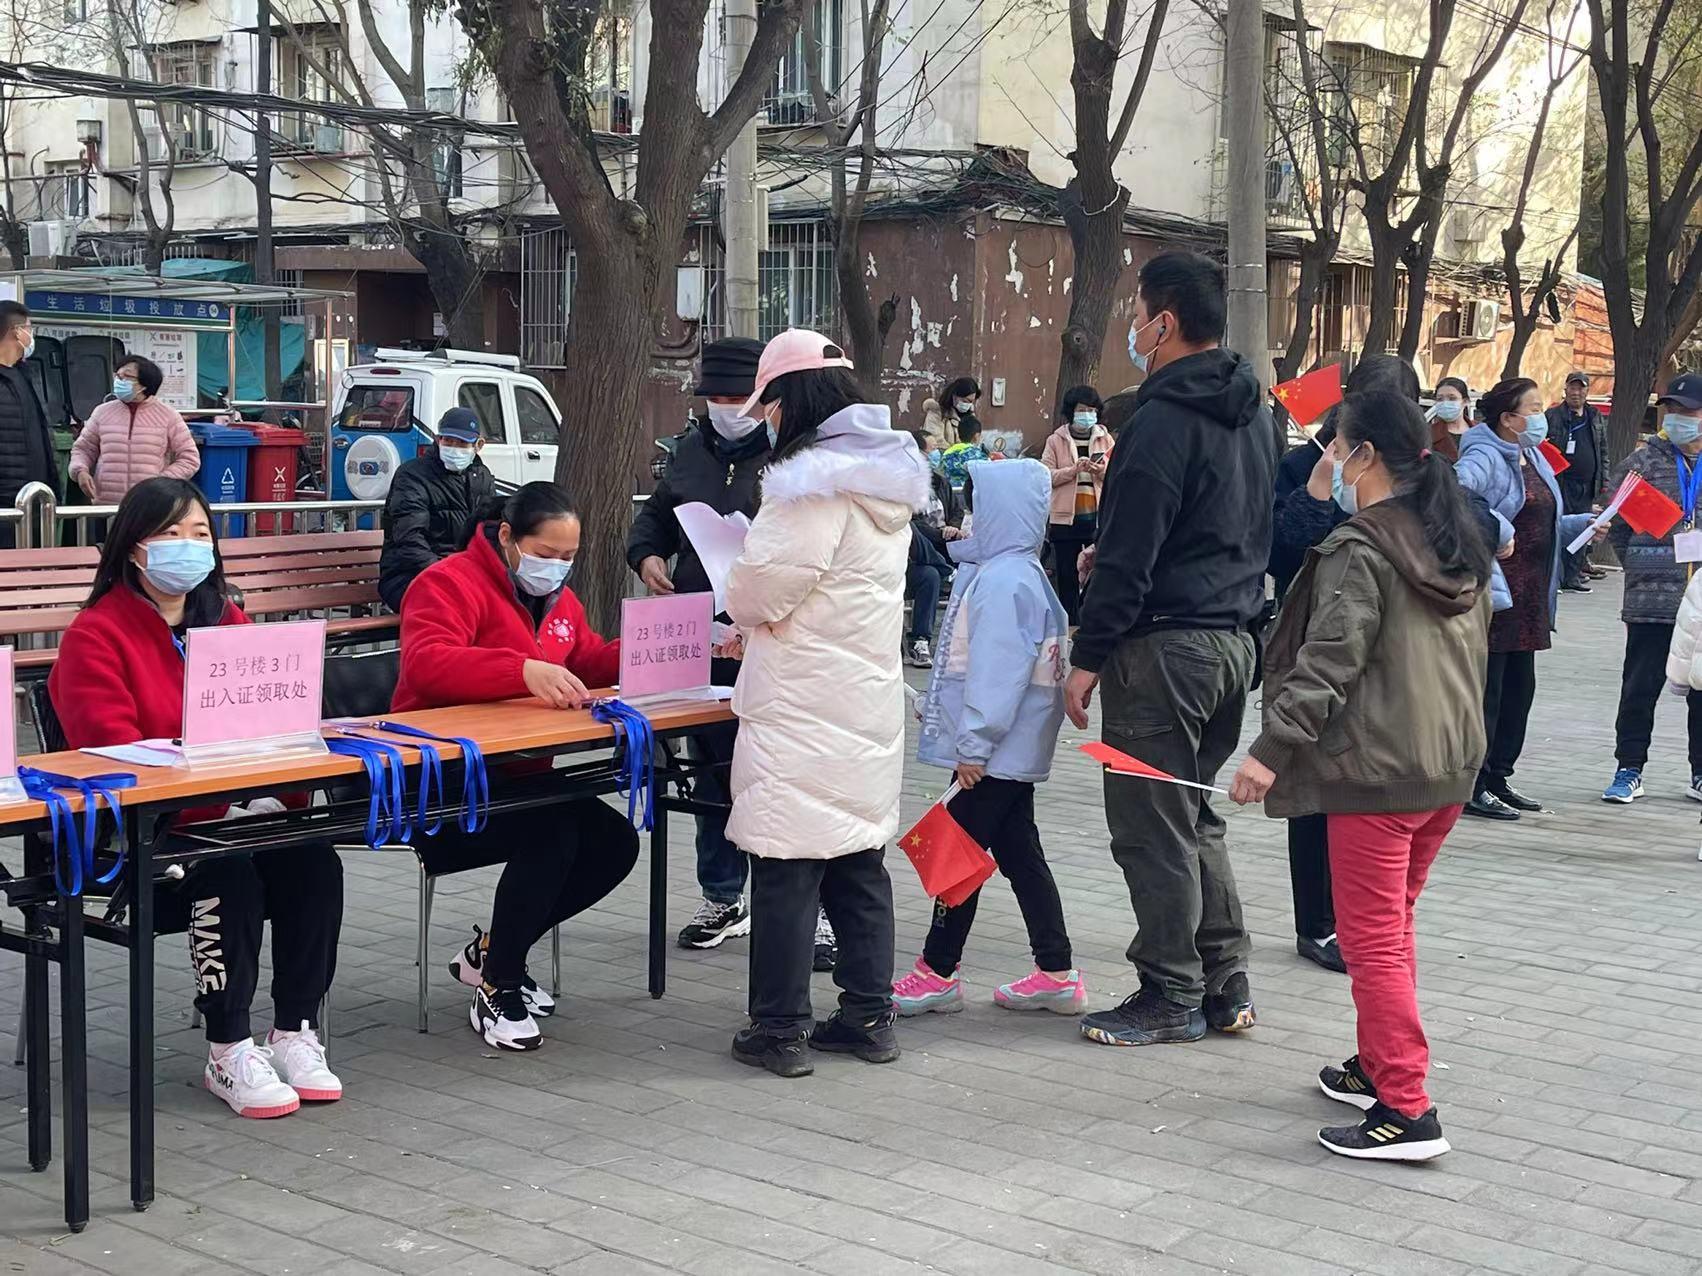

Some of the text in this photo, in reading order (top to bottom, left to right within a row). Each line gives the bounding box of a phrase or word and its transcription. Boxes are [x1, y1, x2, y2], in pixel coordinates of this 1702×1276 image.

[47, 295, 208, 317] 生活垃圾投放点
[631, 642, 702, 666] 出入证领取处
[200, 680, 308, 709] 出入证领取处
